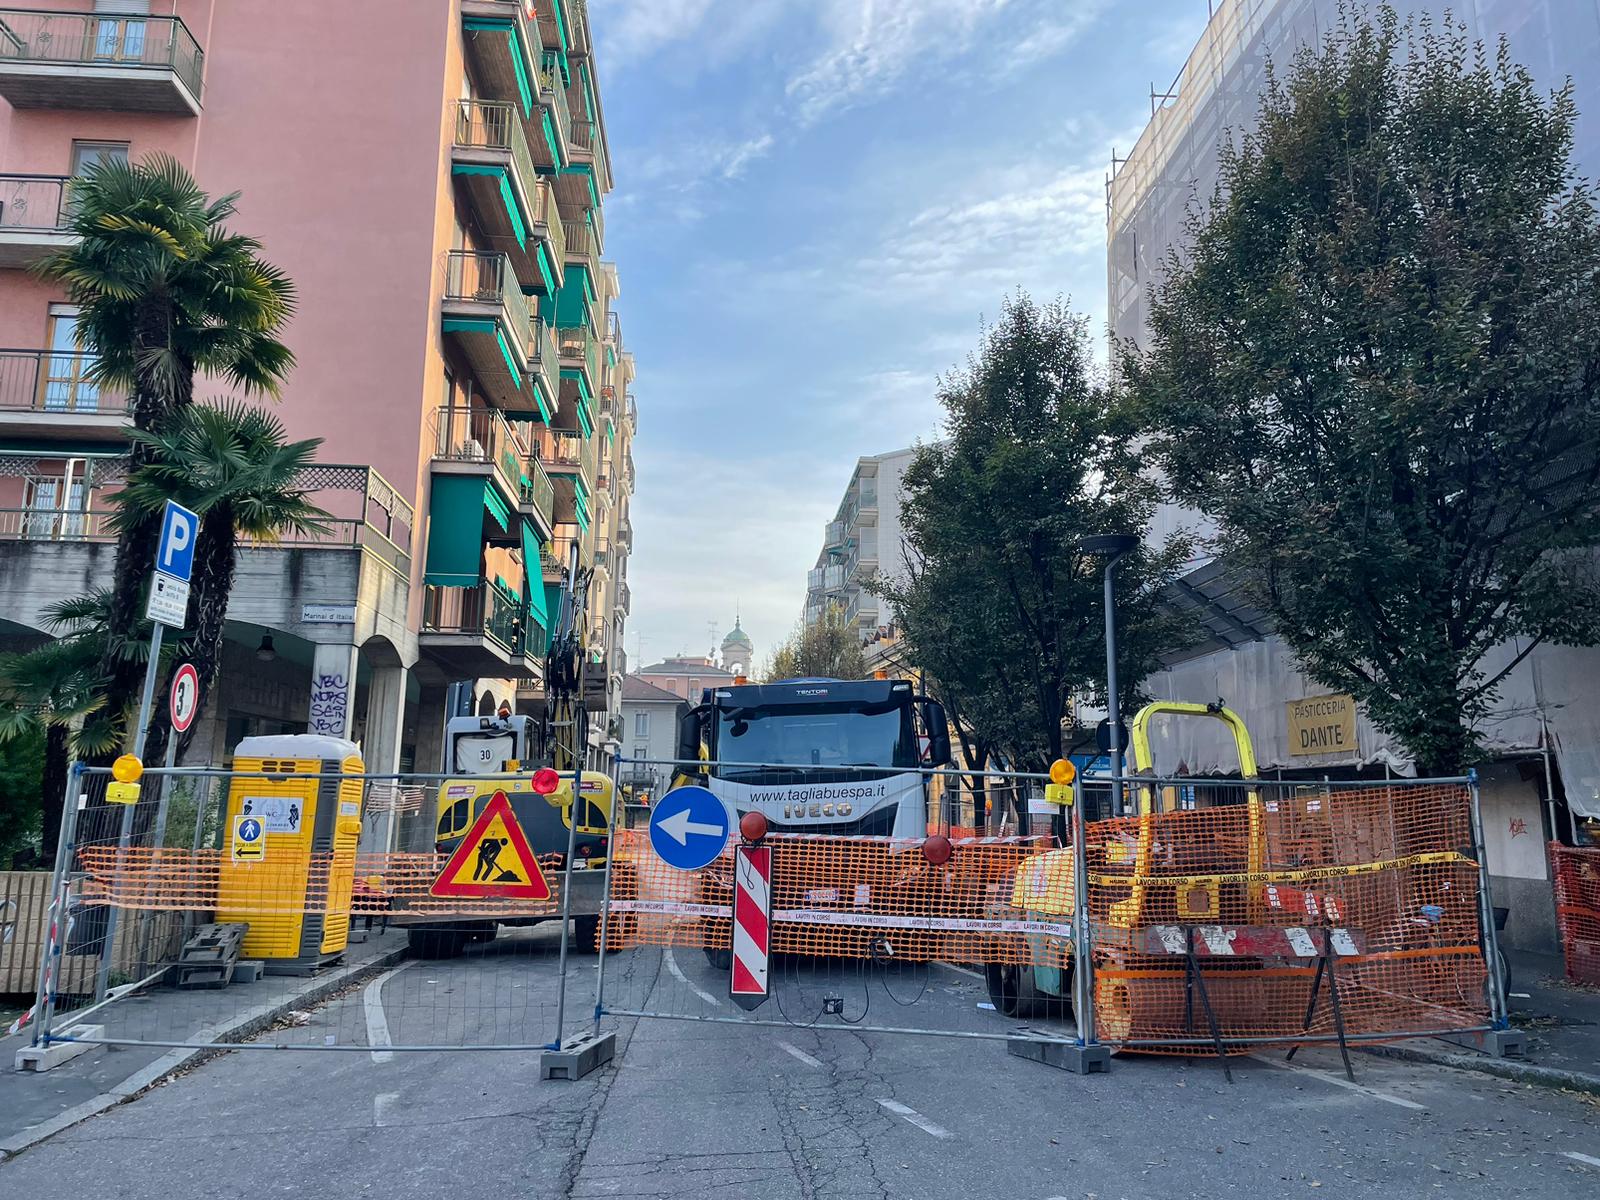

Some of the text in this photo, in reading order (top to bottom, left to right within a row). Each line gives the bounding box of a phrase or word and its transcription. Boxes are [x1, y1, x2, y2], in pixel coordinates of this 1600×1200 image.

[164, 511, 190, 566] P
[1294, 700, 1346, 719] PASTICCERIA
[1300, 724, 1343, 749] DANTE
[480, 749, 491, 760] 30
[750, 784, 885, 803] www.tagliabuespa.it
[784, 802, 852, 819] IVECO
[1136, 878, 1159, 886] LAVORI
[1168, 877, 1189, 885] CORSO
[1219, 875, 1241, 883] LAVORI
[1250, 873, 1269, 882] CORSO
[1299, 870, 1320, 880] LAVORI
[1321, 869, 1329, 878] IN
[1329, 867, 1349, 877] CORSO
[1379, 861, 1398, 871] LAVORI
[966, 920, 982, 928] LAVORI
[987, 921, 1002, 929] CORSO
[1023, 923, 1039, 931] LAVORI
[1044, 924, 1060, 933] CORSO
